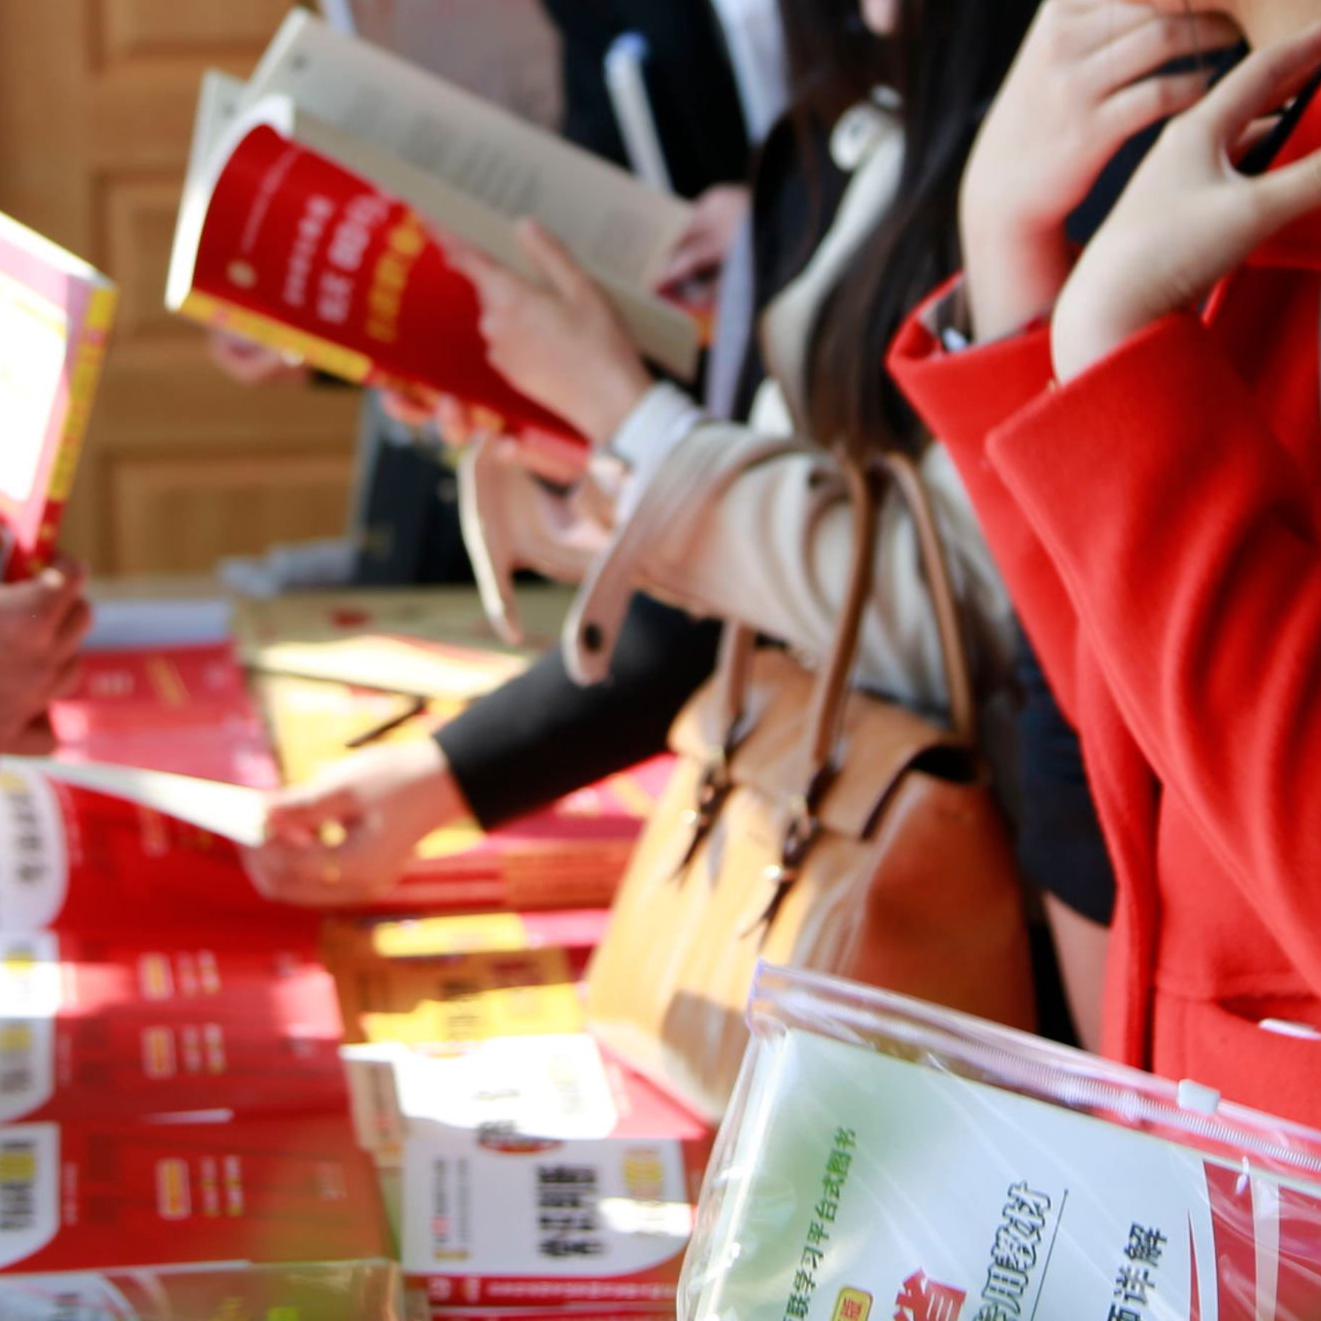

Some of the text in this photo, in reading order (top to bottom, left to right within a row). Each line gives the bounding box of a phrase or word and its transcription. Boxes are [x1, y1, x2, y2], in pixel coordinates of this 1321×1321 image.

[782, 1127, 857, 1321] 联学习平台式图书
[836, 1297, 863, 1321] 版
